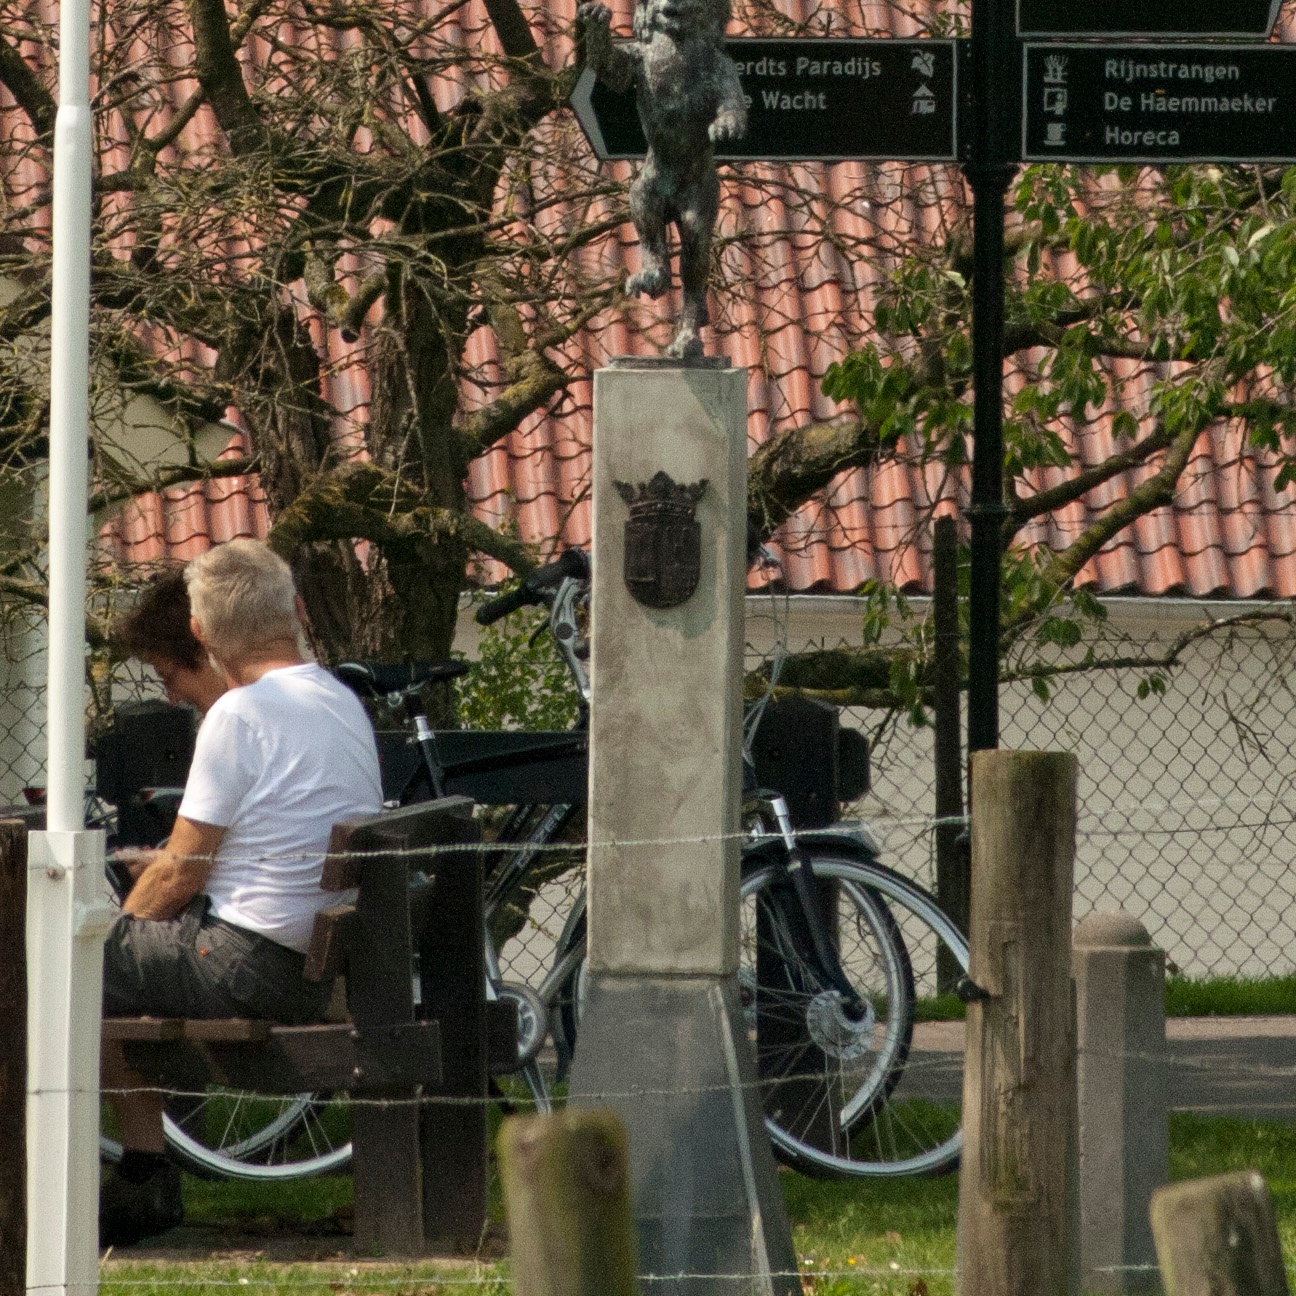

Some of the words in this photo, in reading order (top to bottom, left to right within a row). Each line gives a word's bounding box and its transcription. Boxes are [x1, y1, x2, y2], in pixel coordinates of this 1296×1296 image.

[796, 56, 882, 80] Paradijs
[1104, 58, 1240, 84] Rijnstrangen
[761, 90, 827, 110] Wacht
[1104, 91, 1133, 112] De
[1140, 92, 1277, 113] Haemmaeker
[1105, 125, 1180, 146] Horeca
